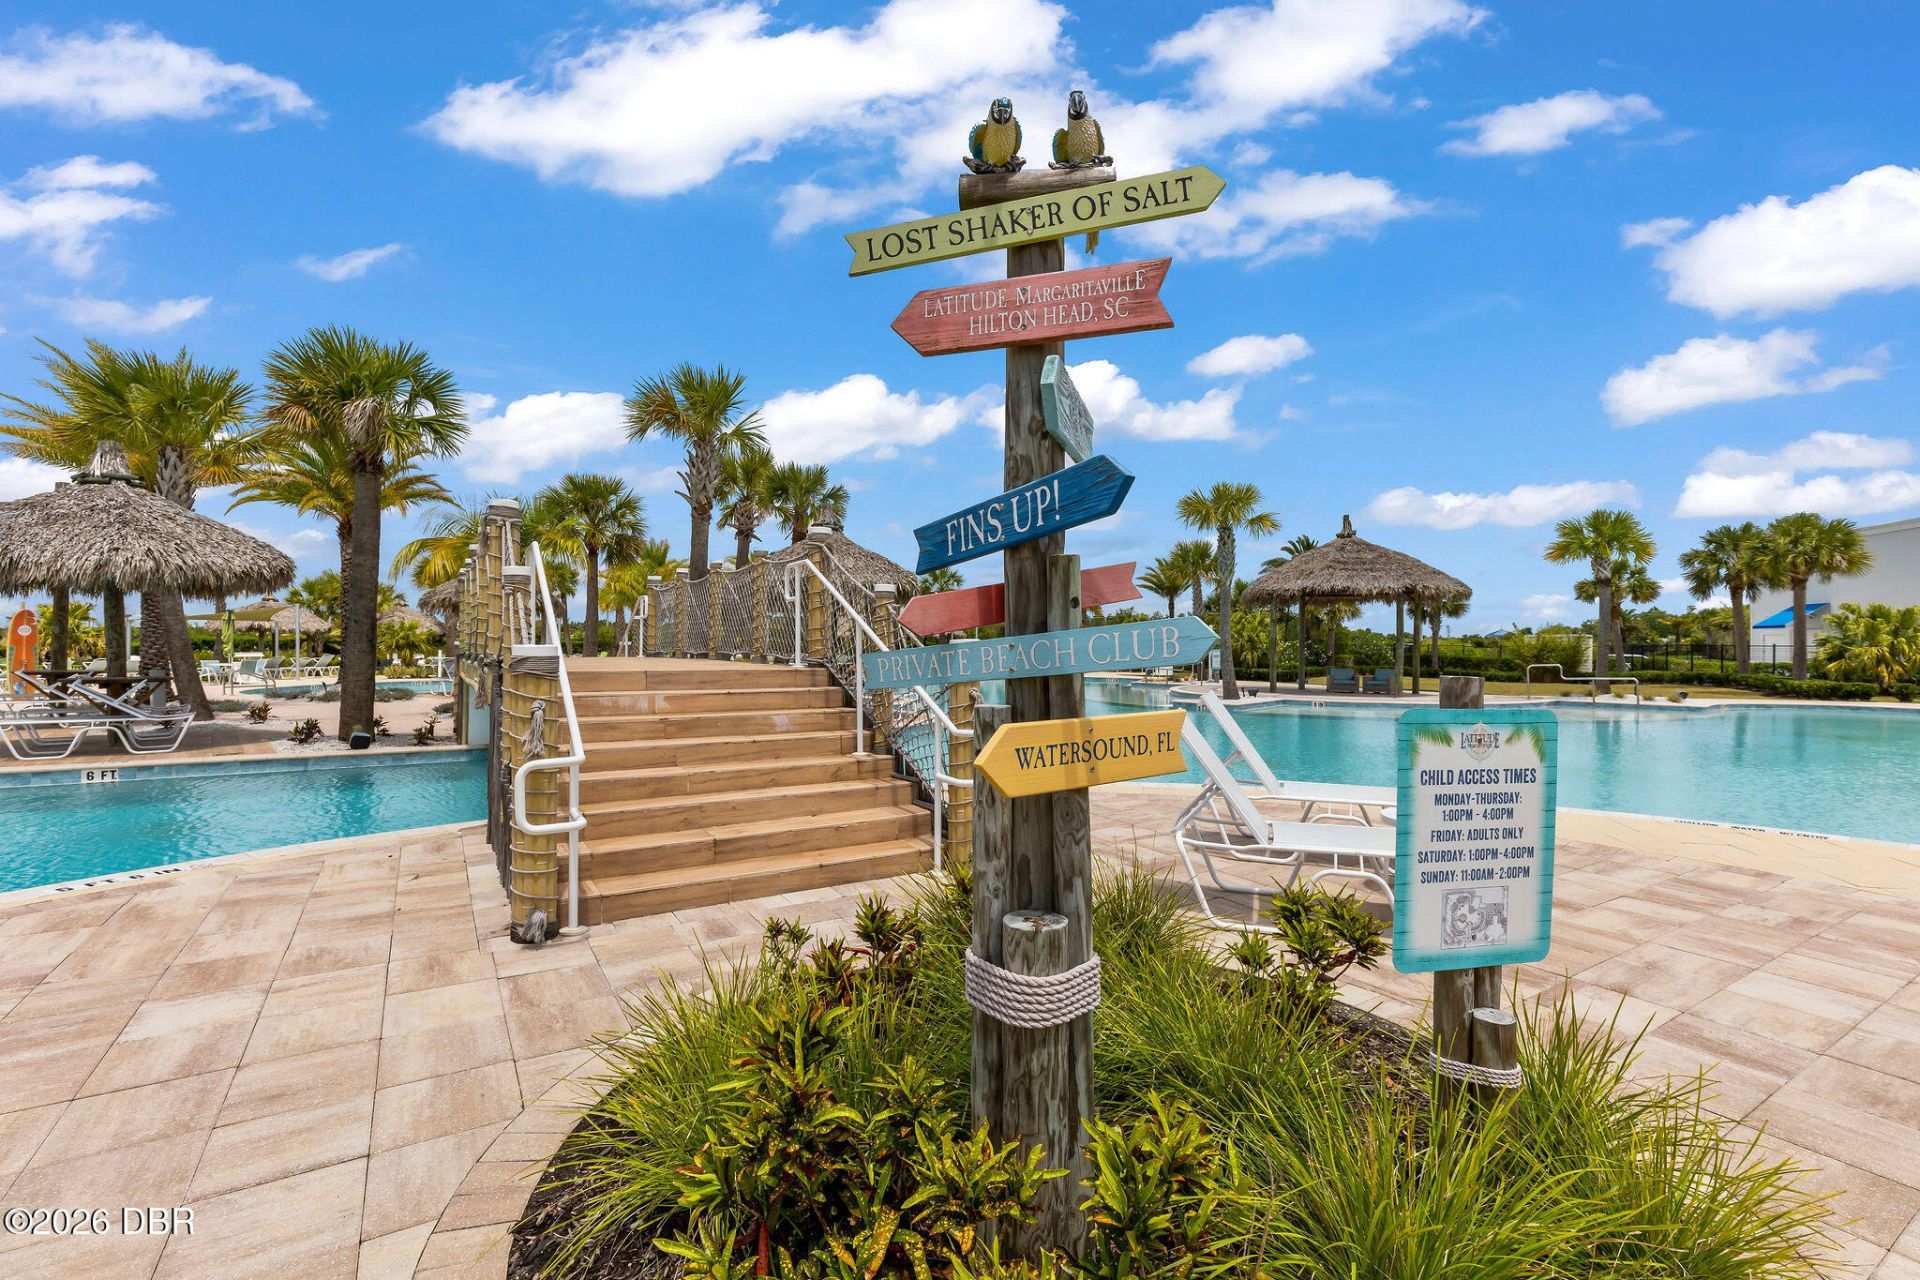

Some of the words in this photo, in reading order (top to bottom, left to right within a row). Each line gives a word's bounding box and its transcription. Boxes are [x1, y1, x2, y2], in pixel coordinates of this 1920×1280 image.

[866, 225, 938, 262] LOST
[949, 202, 1064, 247] SHAKER
[1072, 192, 1111, 221] OF
[1123, 176, 1193, 212] SALT
[924, 288, 1008, 318] LATITUDE
[969, 310, 1037, 336] HILTON
[1044, 301, 1098, 326] HEAD,
[1104, 296, 1129, 319] SC
[946, 503, 1004, 556] FINS
[1012, 479, 1061, 534] UP!
[877, 649, 971, 683] PRIVATE
[980, 636, 1076, 674] BEACH
[1088, 625, 1181, 664] CLUB
[1015, 734, 1153, 770] WATERSOUND,
[1157, 732, 1175, 753] FL
[86, 771, 95, 781] 6
[1420, 770, 1454, 786] CHILD
[1457, 768, 1500, 785] ACCESS
[1503, 768, 1537, 784] TIMES
[1434, 792, 1522, 806] MONDAY-THURSDAY:
[1442, 809, 1473, 822] 1:00PM
[1482, 807, 1514, 820] 4:00PM
[1431, 829, 1465, 843] FRIDAY:
[1467, 828, 1500, 841] ADULTS
[1502, 827, 1524, 840] ONLY
[1418, 850, 1466, 864] SATURDAY:
[1420, 869, 1459, 884] SUNDAY:
